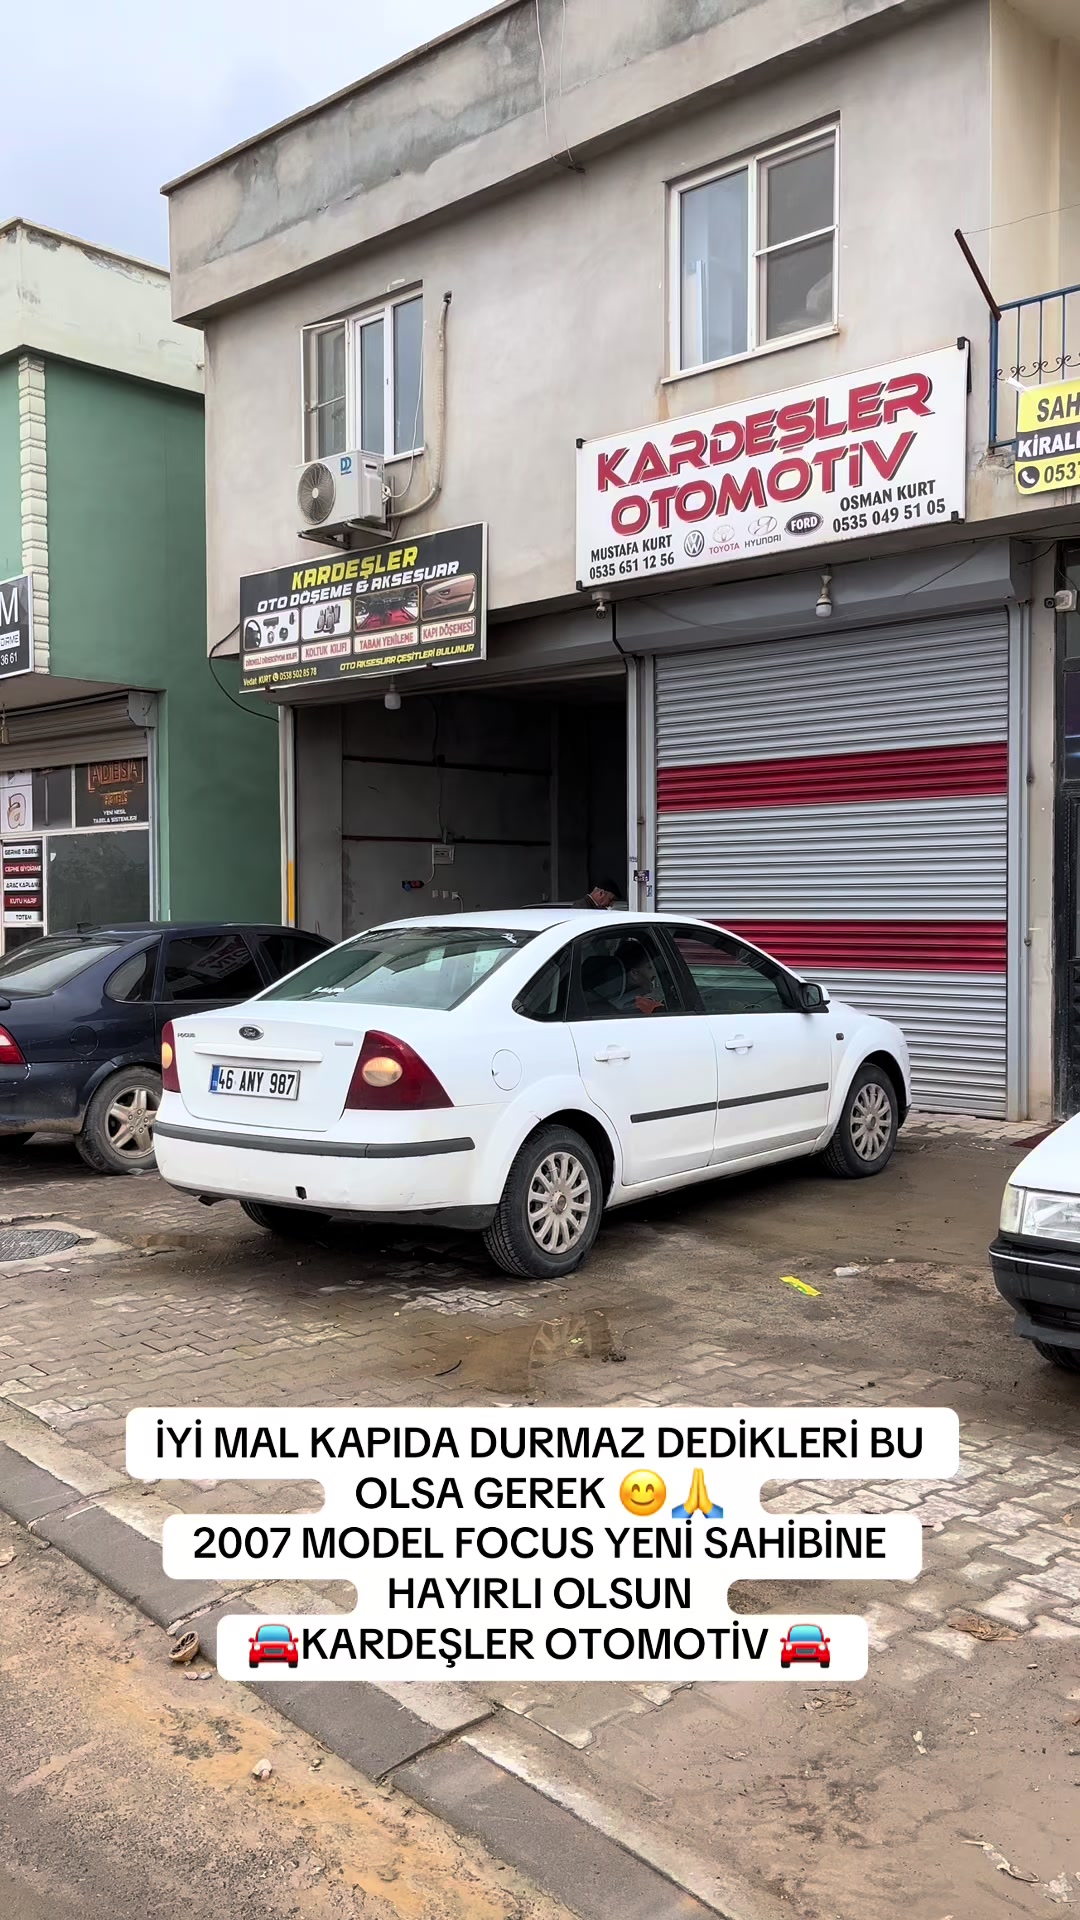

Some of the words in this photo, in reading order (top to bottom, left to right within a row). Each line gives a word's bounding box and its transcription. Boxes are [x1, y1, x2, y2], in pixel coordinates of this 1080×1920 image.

[598, 373, 936, 493] KARDEŞLER
[610, 430, 918, 537] OTOMOTİV
[1043, 461, 1080, 484] 053
[840, 488, 893, 512] OSMAN
[897, 479, 936, 501] KURT
[790, 516, 818, 532] FORD
[833, 513, 868, 533] 0535
[872, 507, 899, 525] 049
[904, 502, 921, 520] 51
[927, 498, 946, 515] 05
[591, 543, 639, 563] MUSTAFA
[643, 534, 673, 551] KURT
[709, 542, 740, 555] TOYOTA
[744, 534, 782, 549] HYUNDAI
[292, 546, 419, 591] KARDEŞLER
[590, 558, 616, 580] 0535
[619, 556, 639, 575] 651
[642, 554, 657, 570] 12
[660, 551, 675, 567] 56
[257, 596, 288, 613] OTO
[290, 582, 353, 607] DÖŞEME
[356, 579, 370, 594] &
[370, 560, 460, 590] AKSESUAR
[359, 639, 381, 650] TABAN
[382, 632, 414, 646] YENİLEME
[423, 626, 438, 639] KAPI
[439, 618, 474, 637] DÖŞEMESİ
[305, 646, 328, 658] KOLTUK
[330, 641, 347, 654] KILIFI
[340, 661, 356, 671] OTO
[356, 655, 396, 669] AKSESUAR
[396, 647, 436, 664] ÇEŞİTLERİ
[436, 643, 475, 657] BULUNUR
[258, 674, 272, 685] KURT
[279, 671, 292, 681] 0538
[293, 669, 303, 679] 502
[303, 668, 310, 677] 85
[310, 667, 317, 676] 78
[219, 1069, 234, 1090] 46
[239, 1070, 264, 1092] ANY
[269, 1073, 296, 1095] 987
